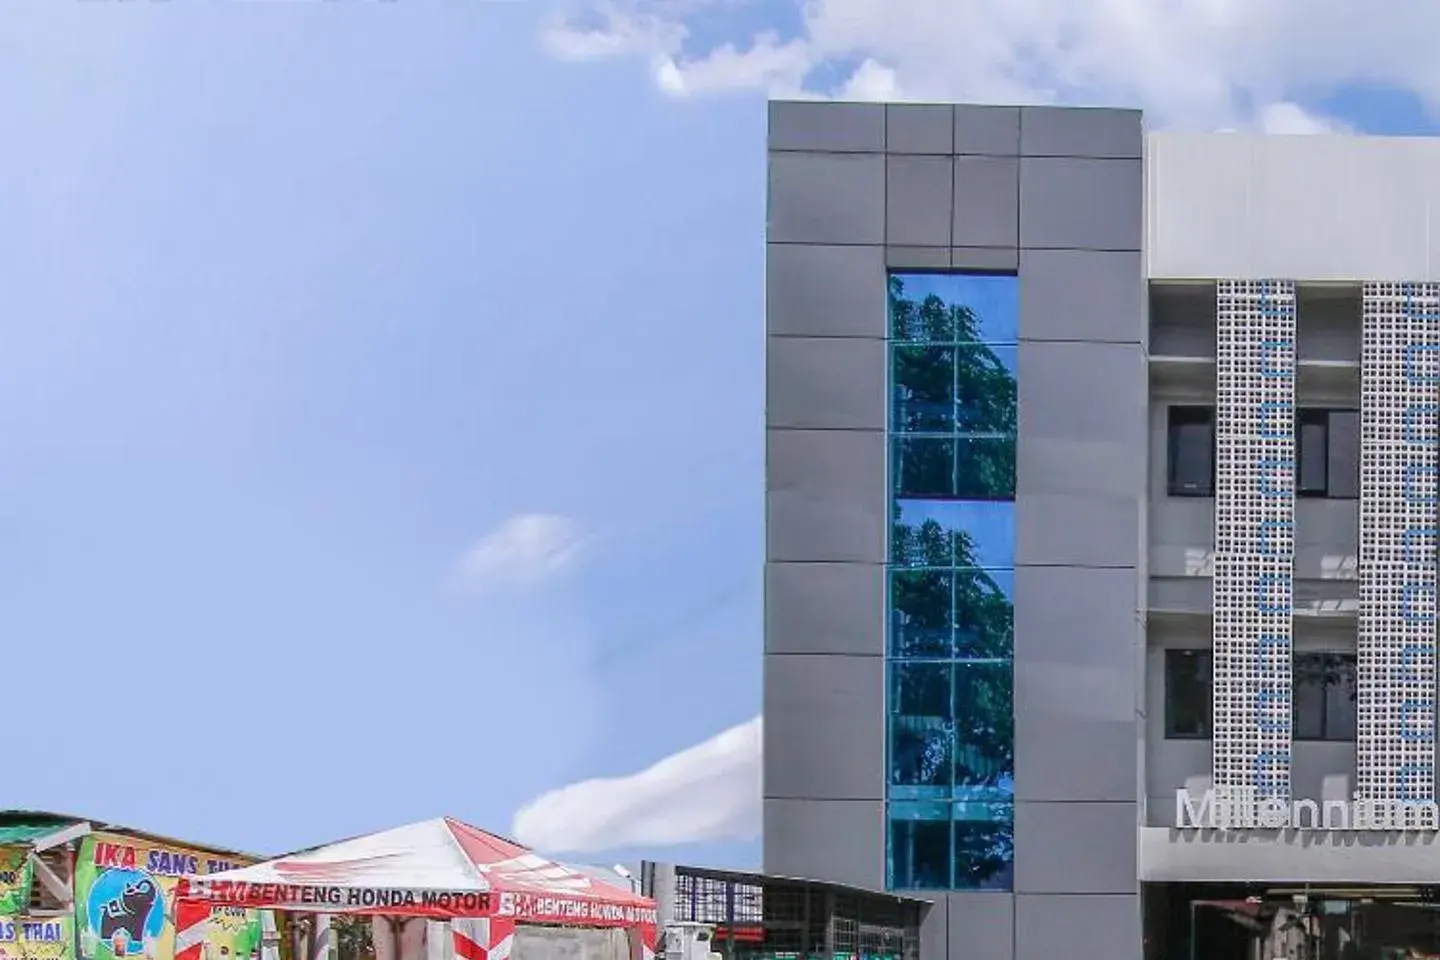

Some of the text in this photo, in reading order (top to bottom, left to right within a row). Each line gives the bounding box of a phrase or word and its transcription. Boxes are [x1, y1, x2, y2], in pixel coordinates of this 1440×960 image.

[1175, 787, 1440, 830] Millennium
[94, 842, 136, 868] IKA
[148, 850, 199, 874] SANS
[249, 884, 341, 905] BENTENG
[347, 886, 416, 907] HONDA
[422, 892, 490, 911] MOTOR
[22, 922, 62, 941] THAI
